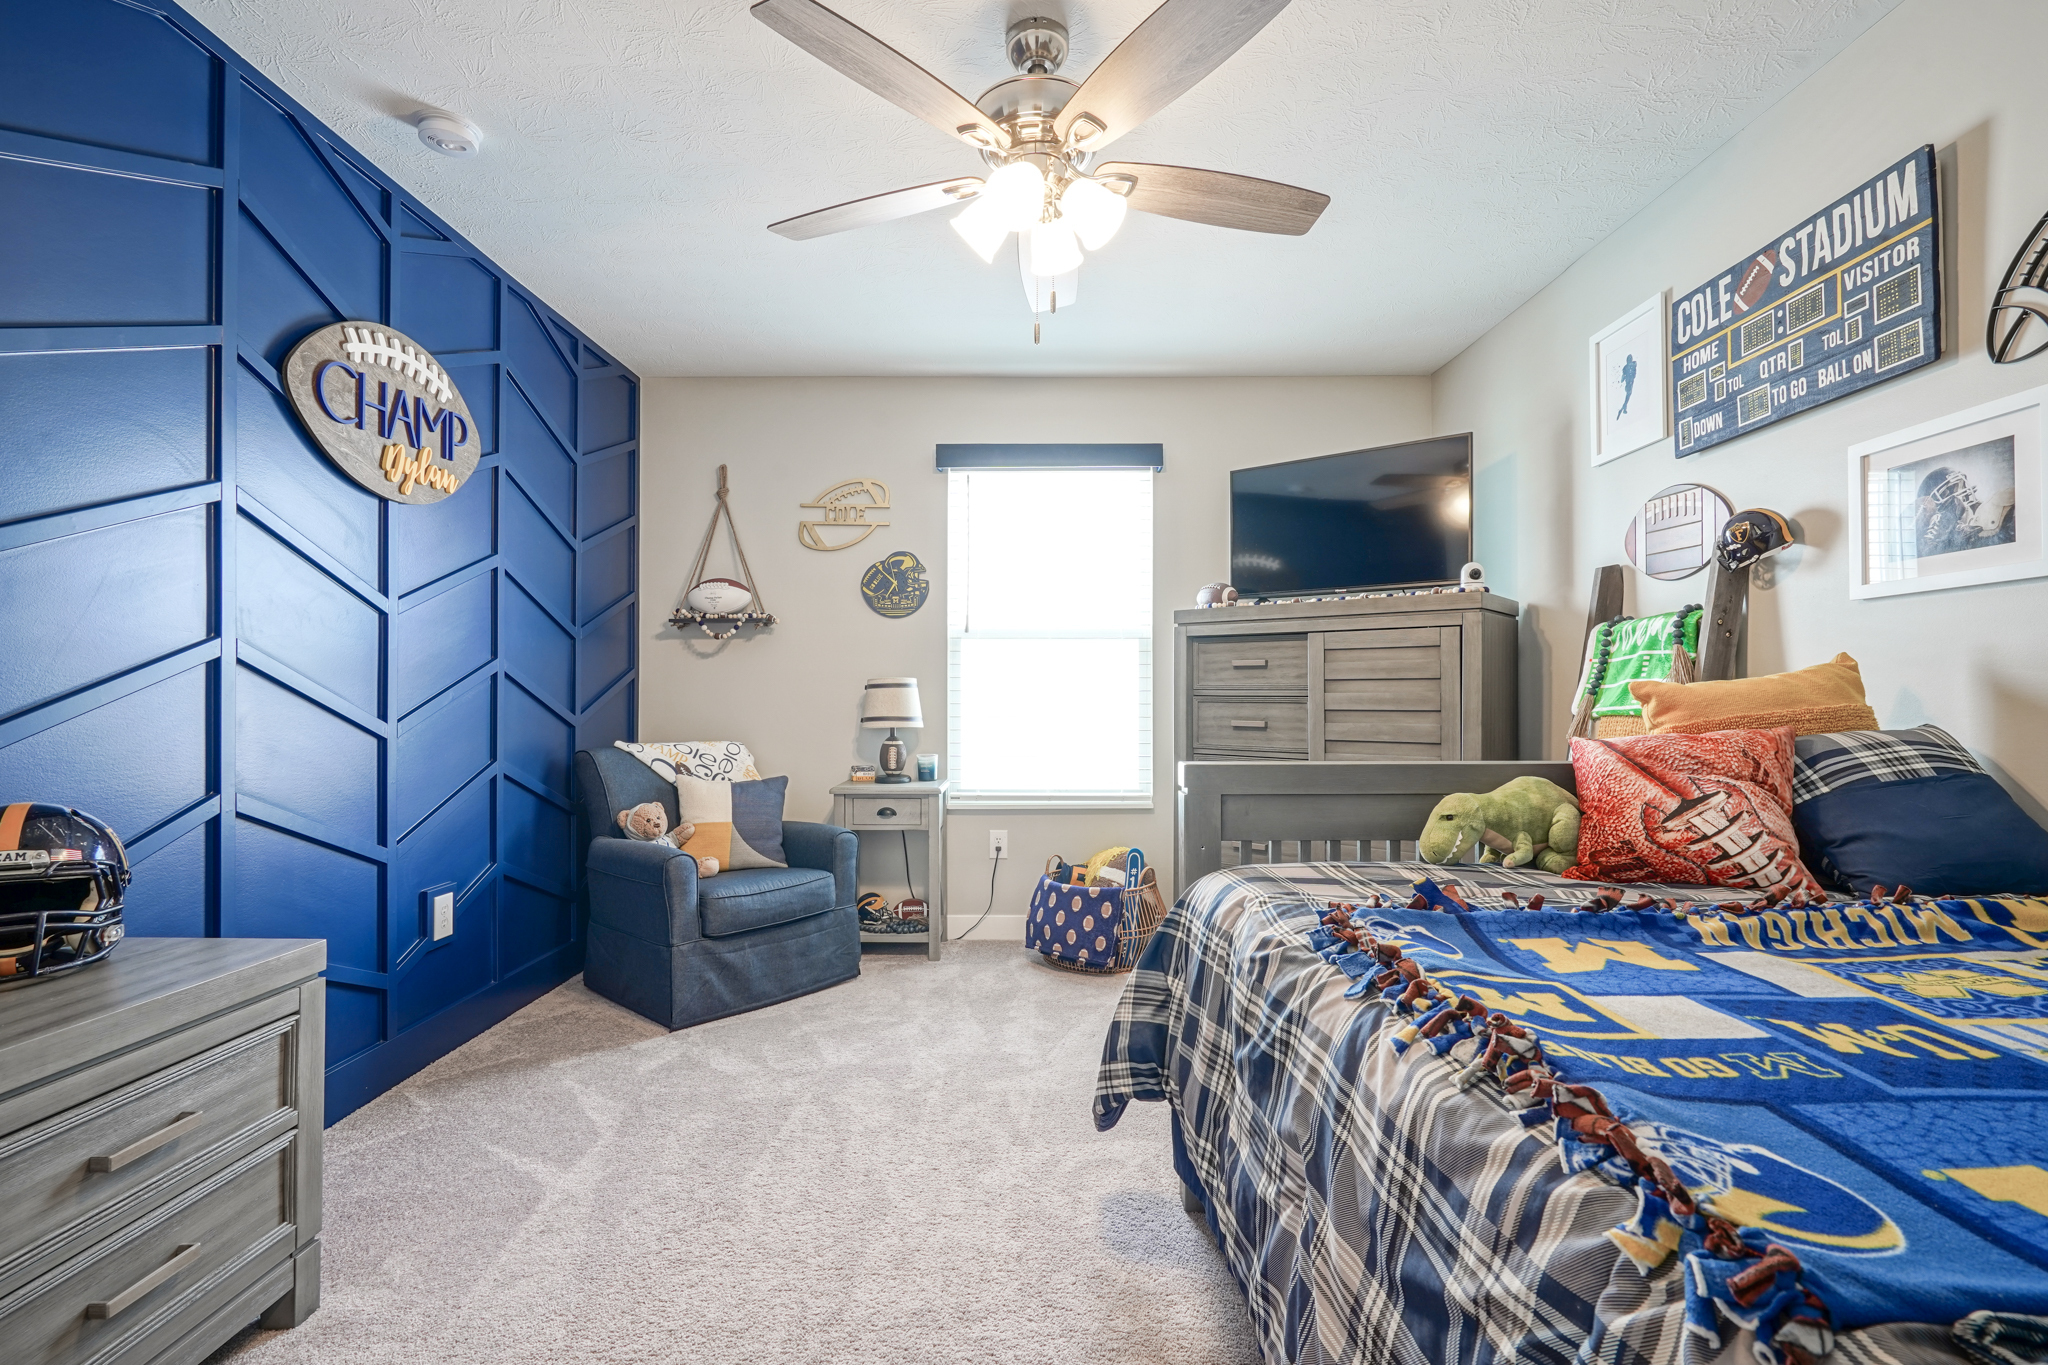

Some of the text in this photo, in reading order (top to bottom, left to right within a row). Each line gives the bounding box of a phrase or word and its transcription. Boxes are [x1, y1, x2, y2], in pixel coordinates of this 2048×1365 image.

[1677, 159, 1919, 345] COLE STADIUM
[1844, 237, 1920, 291] VISITOR
[1822, 331, 1843, 350] TOL
[1683, 341, 1719, 373] HOME
[1760, 351, 1787, 379] QTR
[1818, 360, 1851, 389] BALL
[1853, 348, 1873, 374] ON
[1726, 374, 1745, 393] TOL
[1772, 386, 1787, 406] TO
[1790, 377, 1807, 398] GO
[317, 361, 469, 461] CHAMP
[1694, 411, 1723, 438] DOWN
[381, 443, 460, 496] Dylan
[825, 506, 867, 522] COLE
[0, 852, 27, 862] AM
[1687, 901, 1973, 950] MICHIGAN
[1540, 1039, 1672, 1078] BLUE
[1659, 1057, 1740, 1079] GO
